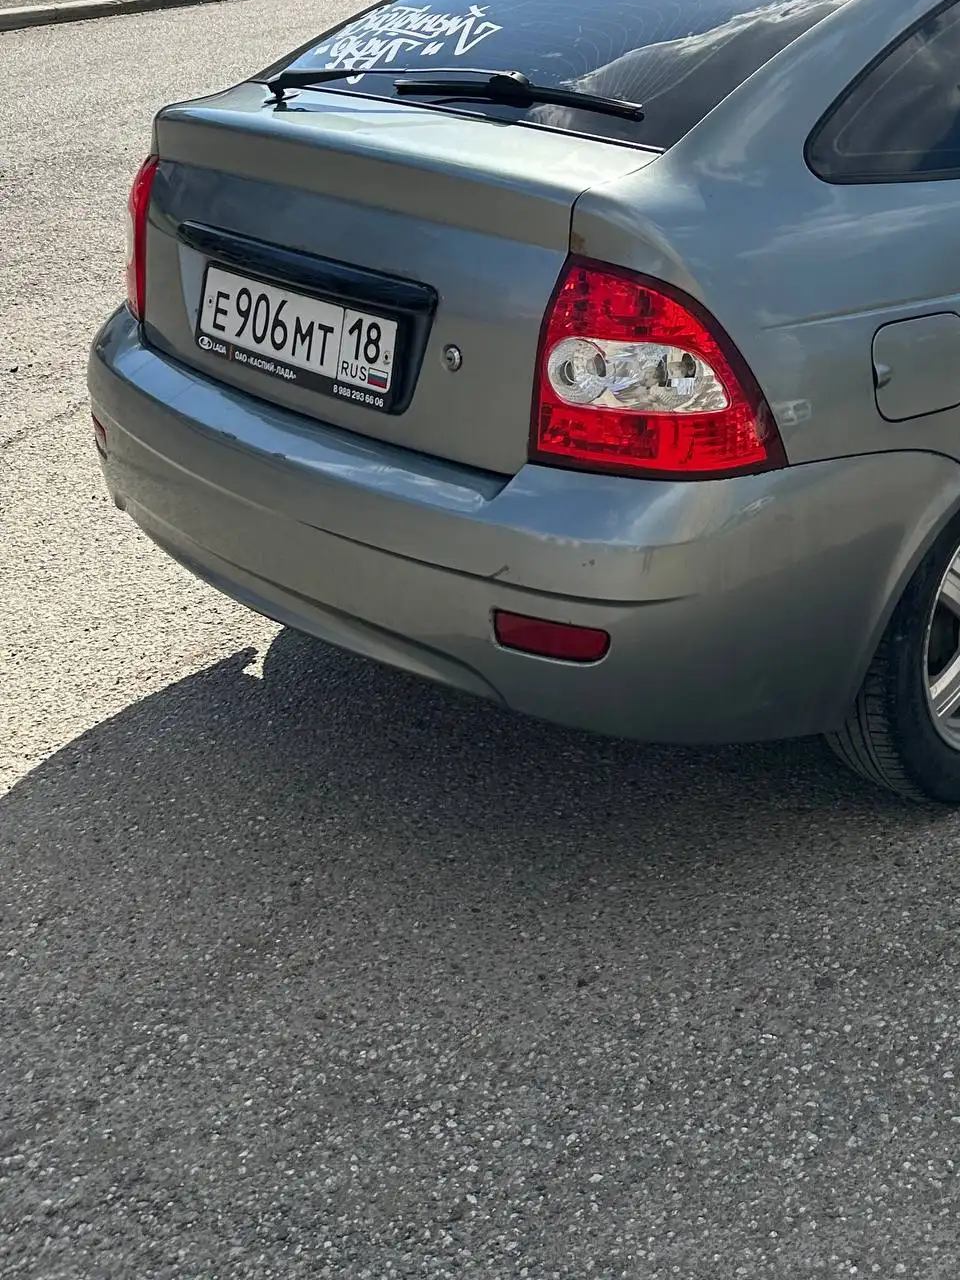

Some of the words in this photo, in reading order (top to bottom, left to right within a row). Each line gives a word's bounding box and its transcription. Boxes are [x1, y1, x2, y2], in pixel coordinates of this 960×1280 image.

[212, 287, 334, 366] Е906МТ
[212, 341, 227, 355] LADA
[234, 350, 247, 362] ОАО
[341, 362, 367, 381] RUS
[333, 384, 338, 393] 8
[351, 390, 365, 402] 293
[374, 397, 384, 408] 06
